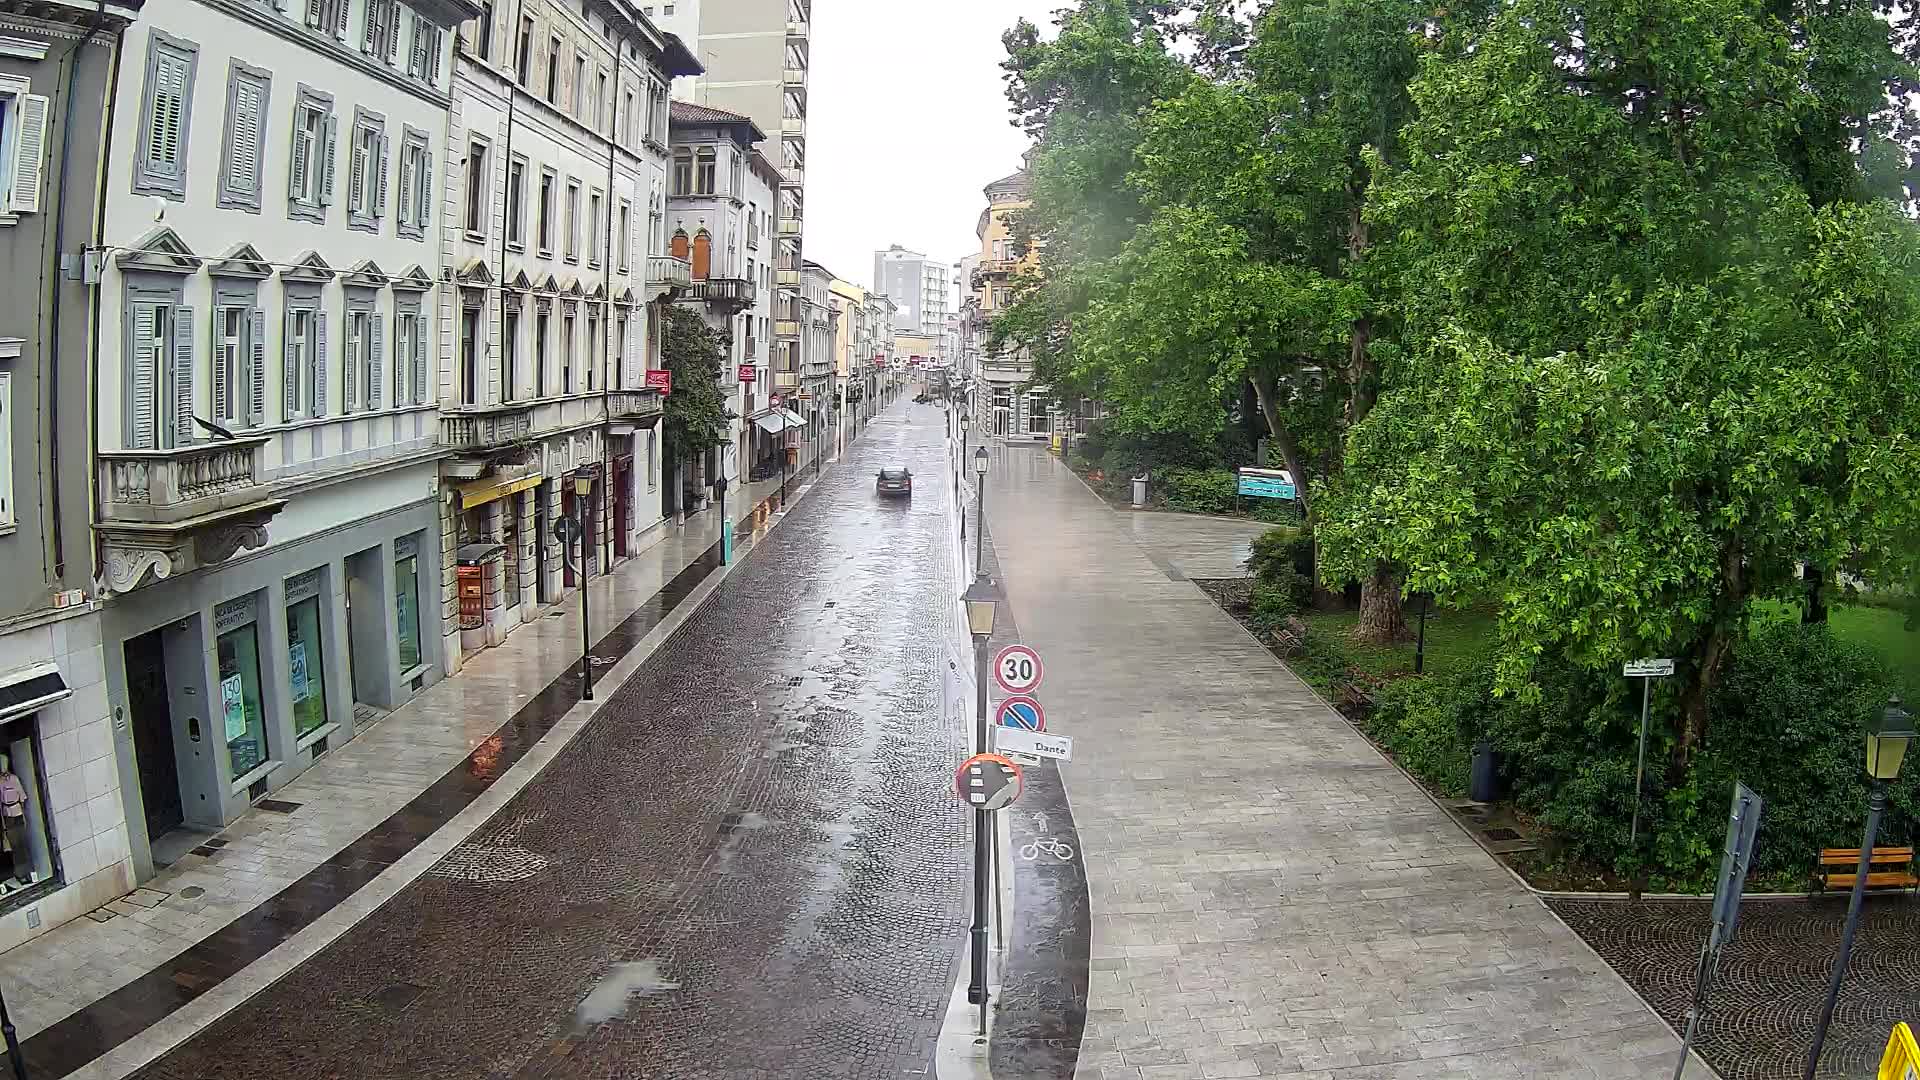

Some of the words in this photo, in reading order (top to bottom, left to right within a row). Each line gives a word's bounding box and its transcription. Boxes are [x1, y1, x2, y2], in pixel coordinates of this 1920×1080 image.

[1005, 659, 1032, 680] 30
[223, 678, 240, 700] 130
[1035, 742, 1066, 755] Dante
